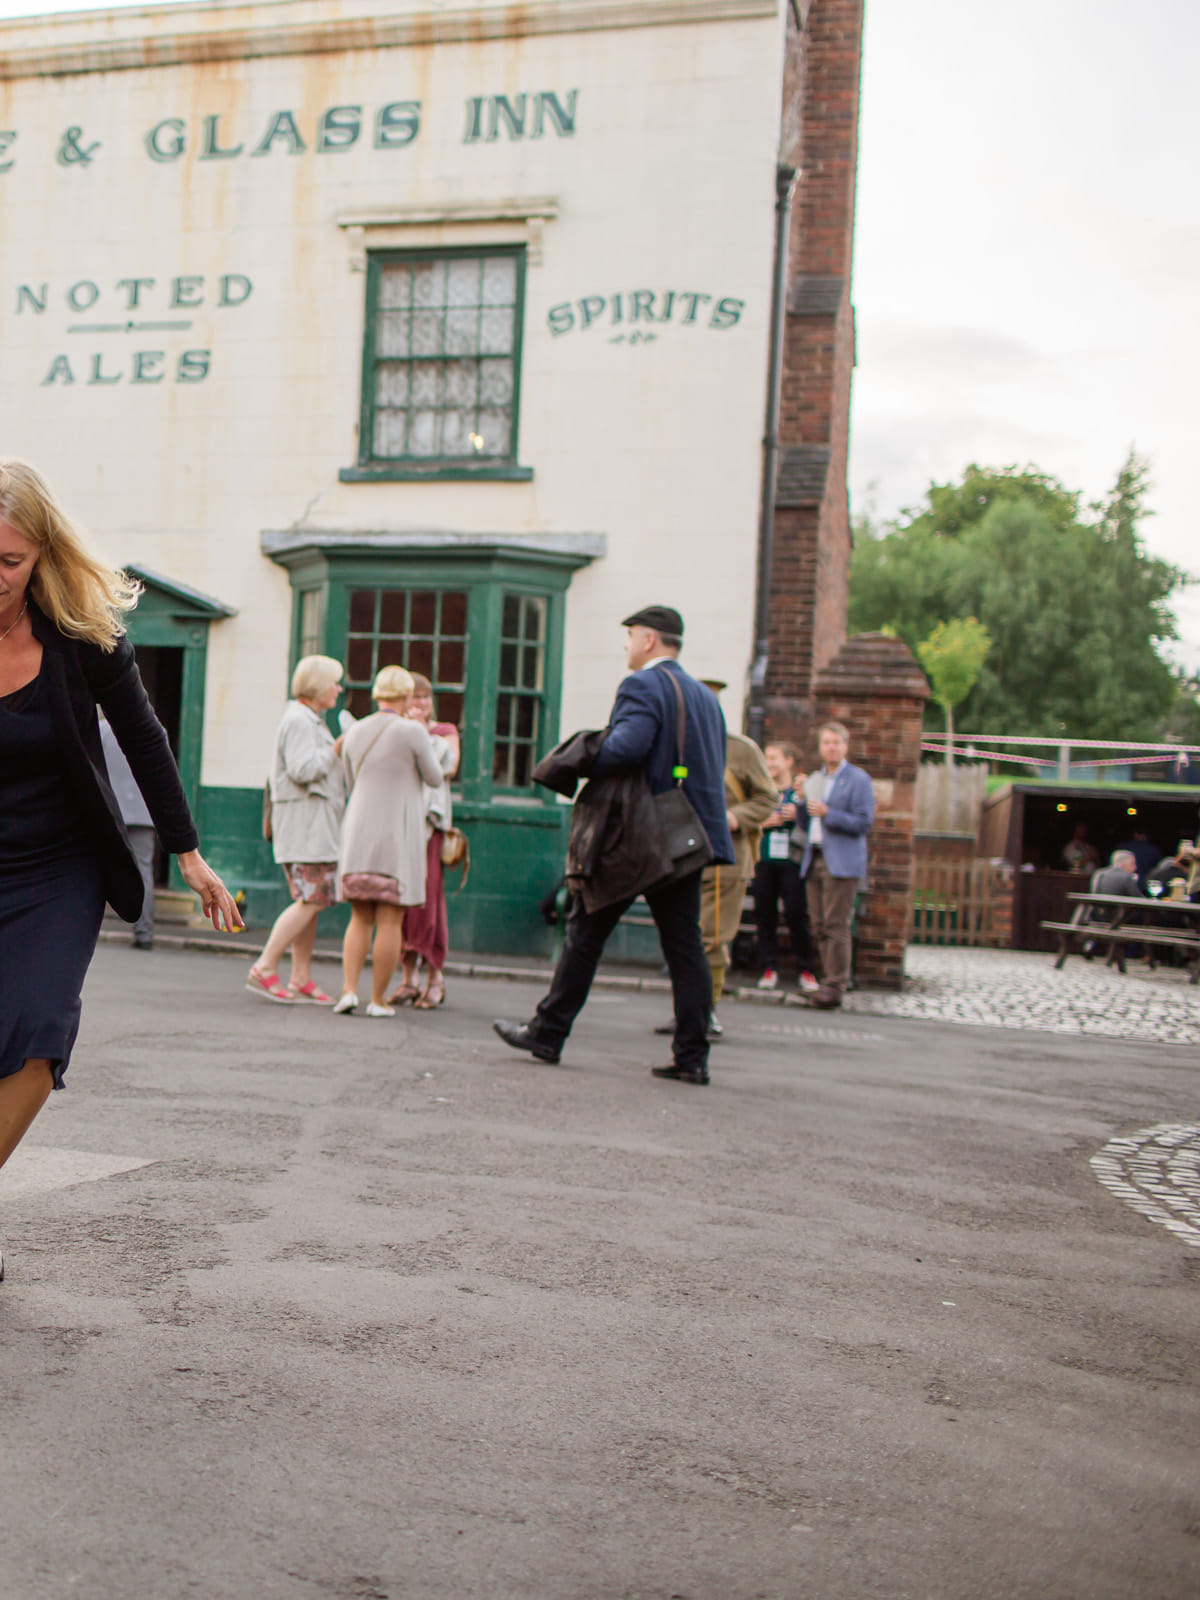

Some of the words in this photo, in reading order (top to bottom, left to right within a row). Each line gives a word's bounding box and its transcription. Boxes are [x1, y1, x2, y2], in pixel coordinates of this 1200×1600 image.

[56, 125, 102, 168] &
[144, 100, 422, 163] GLASS
[462, 88, 580, 144] INN
[16, 274, 254, 315] NOTED
[546, 289, 747, 338] SPIRITS
[40, 349, 212, 386] ALES
